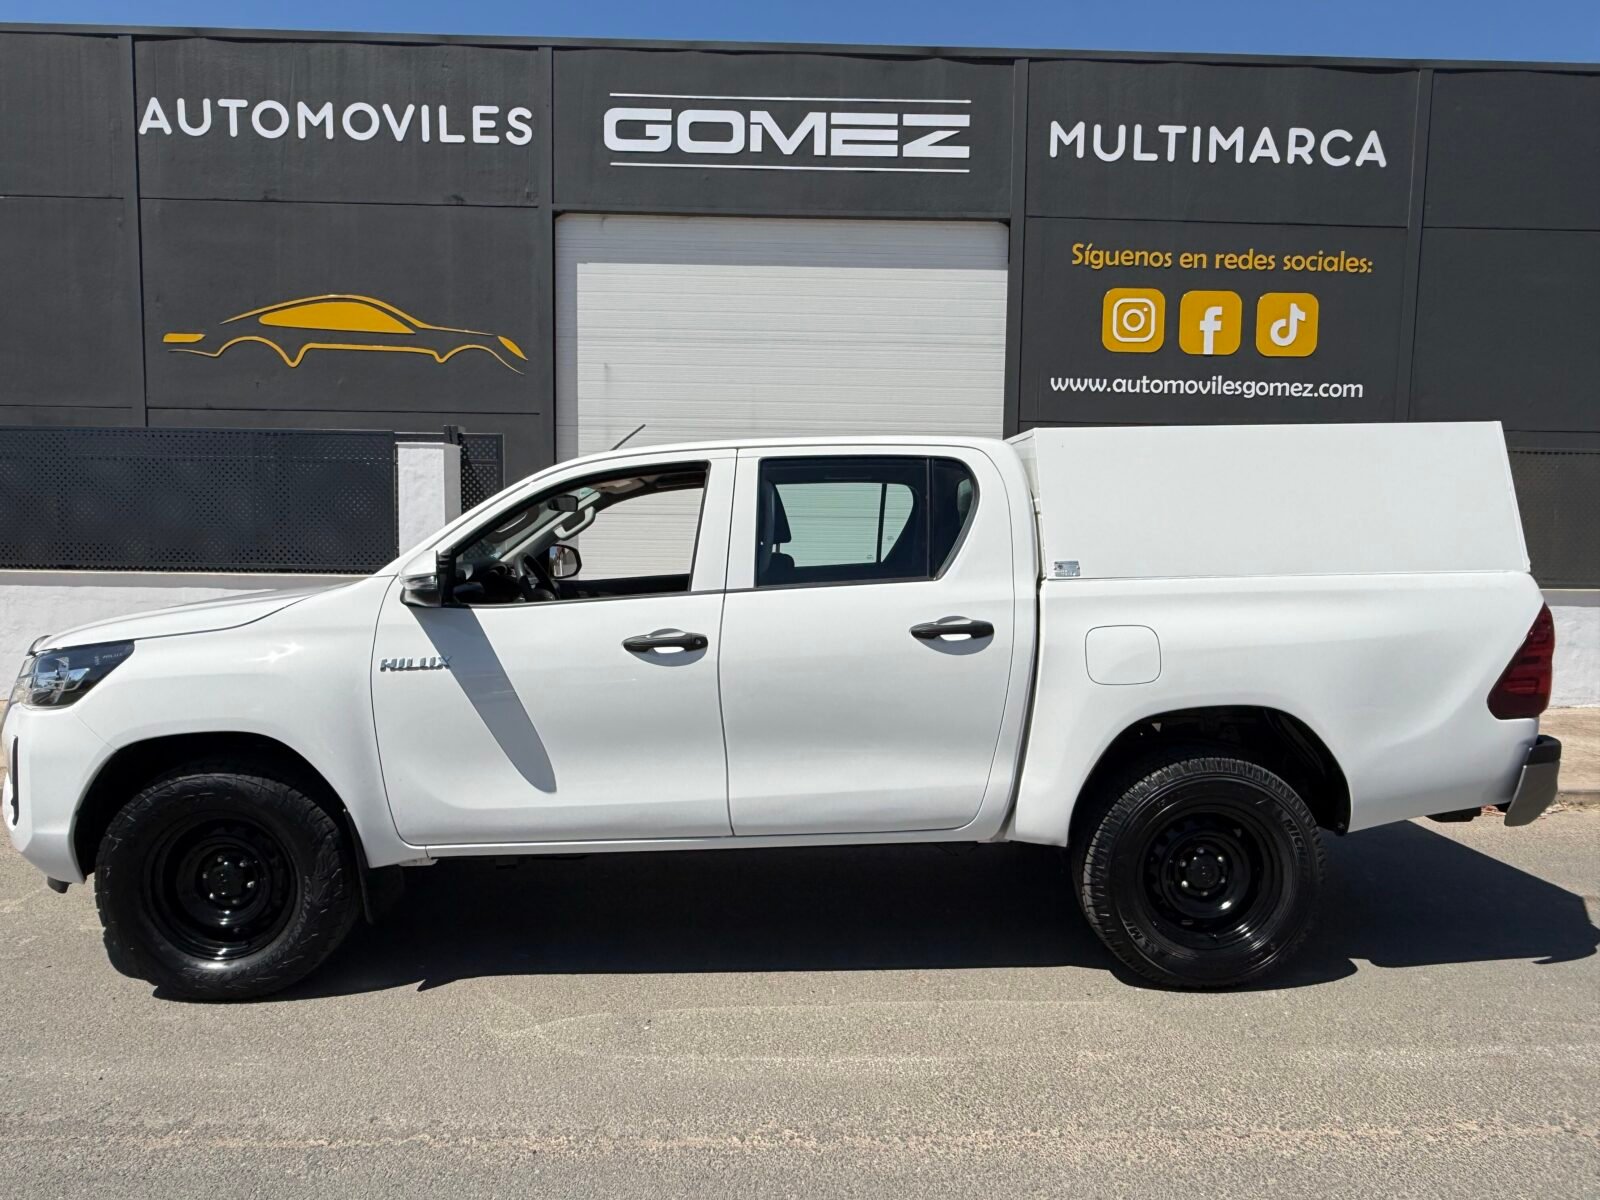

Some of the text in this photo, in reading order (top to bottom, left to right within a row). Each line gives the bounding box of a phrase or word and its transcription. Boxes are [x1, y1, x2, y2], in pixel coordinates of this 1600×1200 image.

[138, 97, 534, 147] AUTOMOVILES
[603, 107, 972, 160] GOMEZ
[1049, 120, 1388, 168] MULTIMARCA
[1071, 243, 1374, 274] Síguenos en redes sociales:
[1050, 375, 1364, 399] www.automovilesgomez.com
[380, 656, 452, 672] HILUX
